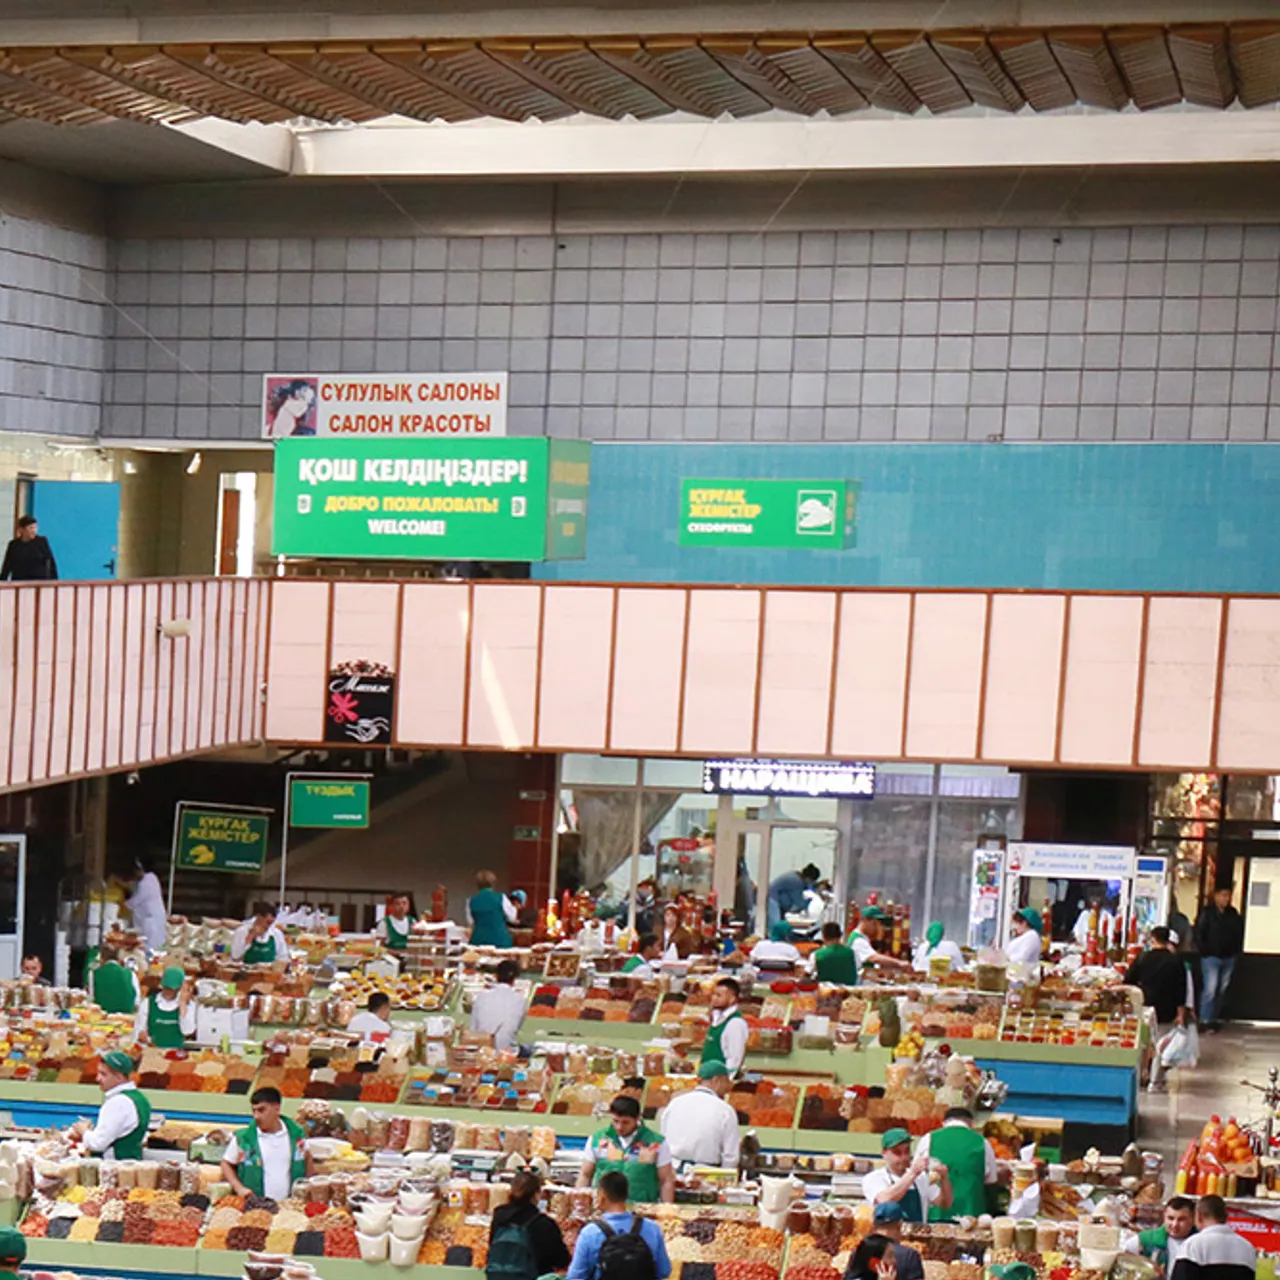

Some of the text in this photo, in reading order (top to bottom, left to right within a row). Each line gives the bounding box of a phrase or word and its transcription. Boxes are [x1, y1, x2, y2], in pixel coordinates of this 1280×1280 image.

[417, 383, 500, 402] САЛОНЫ
[329, 414, 491, 433] САЛОН КРАСОТЫ
[298, 459, 358, 486] ҚОШ
[363, 459, 529, 487] КЕЛДІҢІЗДЕР!
[323, 495, 499, 514] ДОБРО ПОЖАЛОВАТЬ!
[367, 519, 446, 536] WELCOME!
